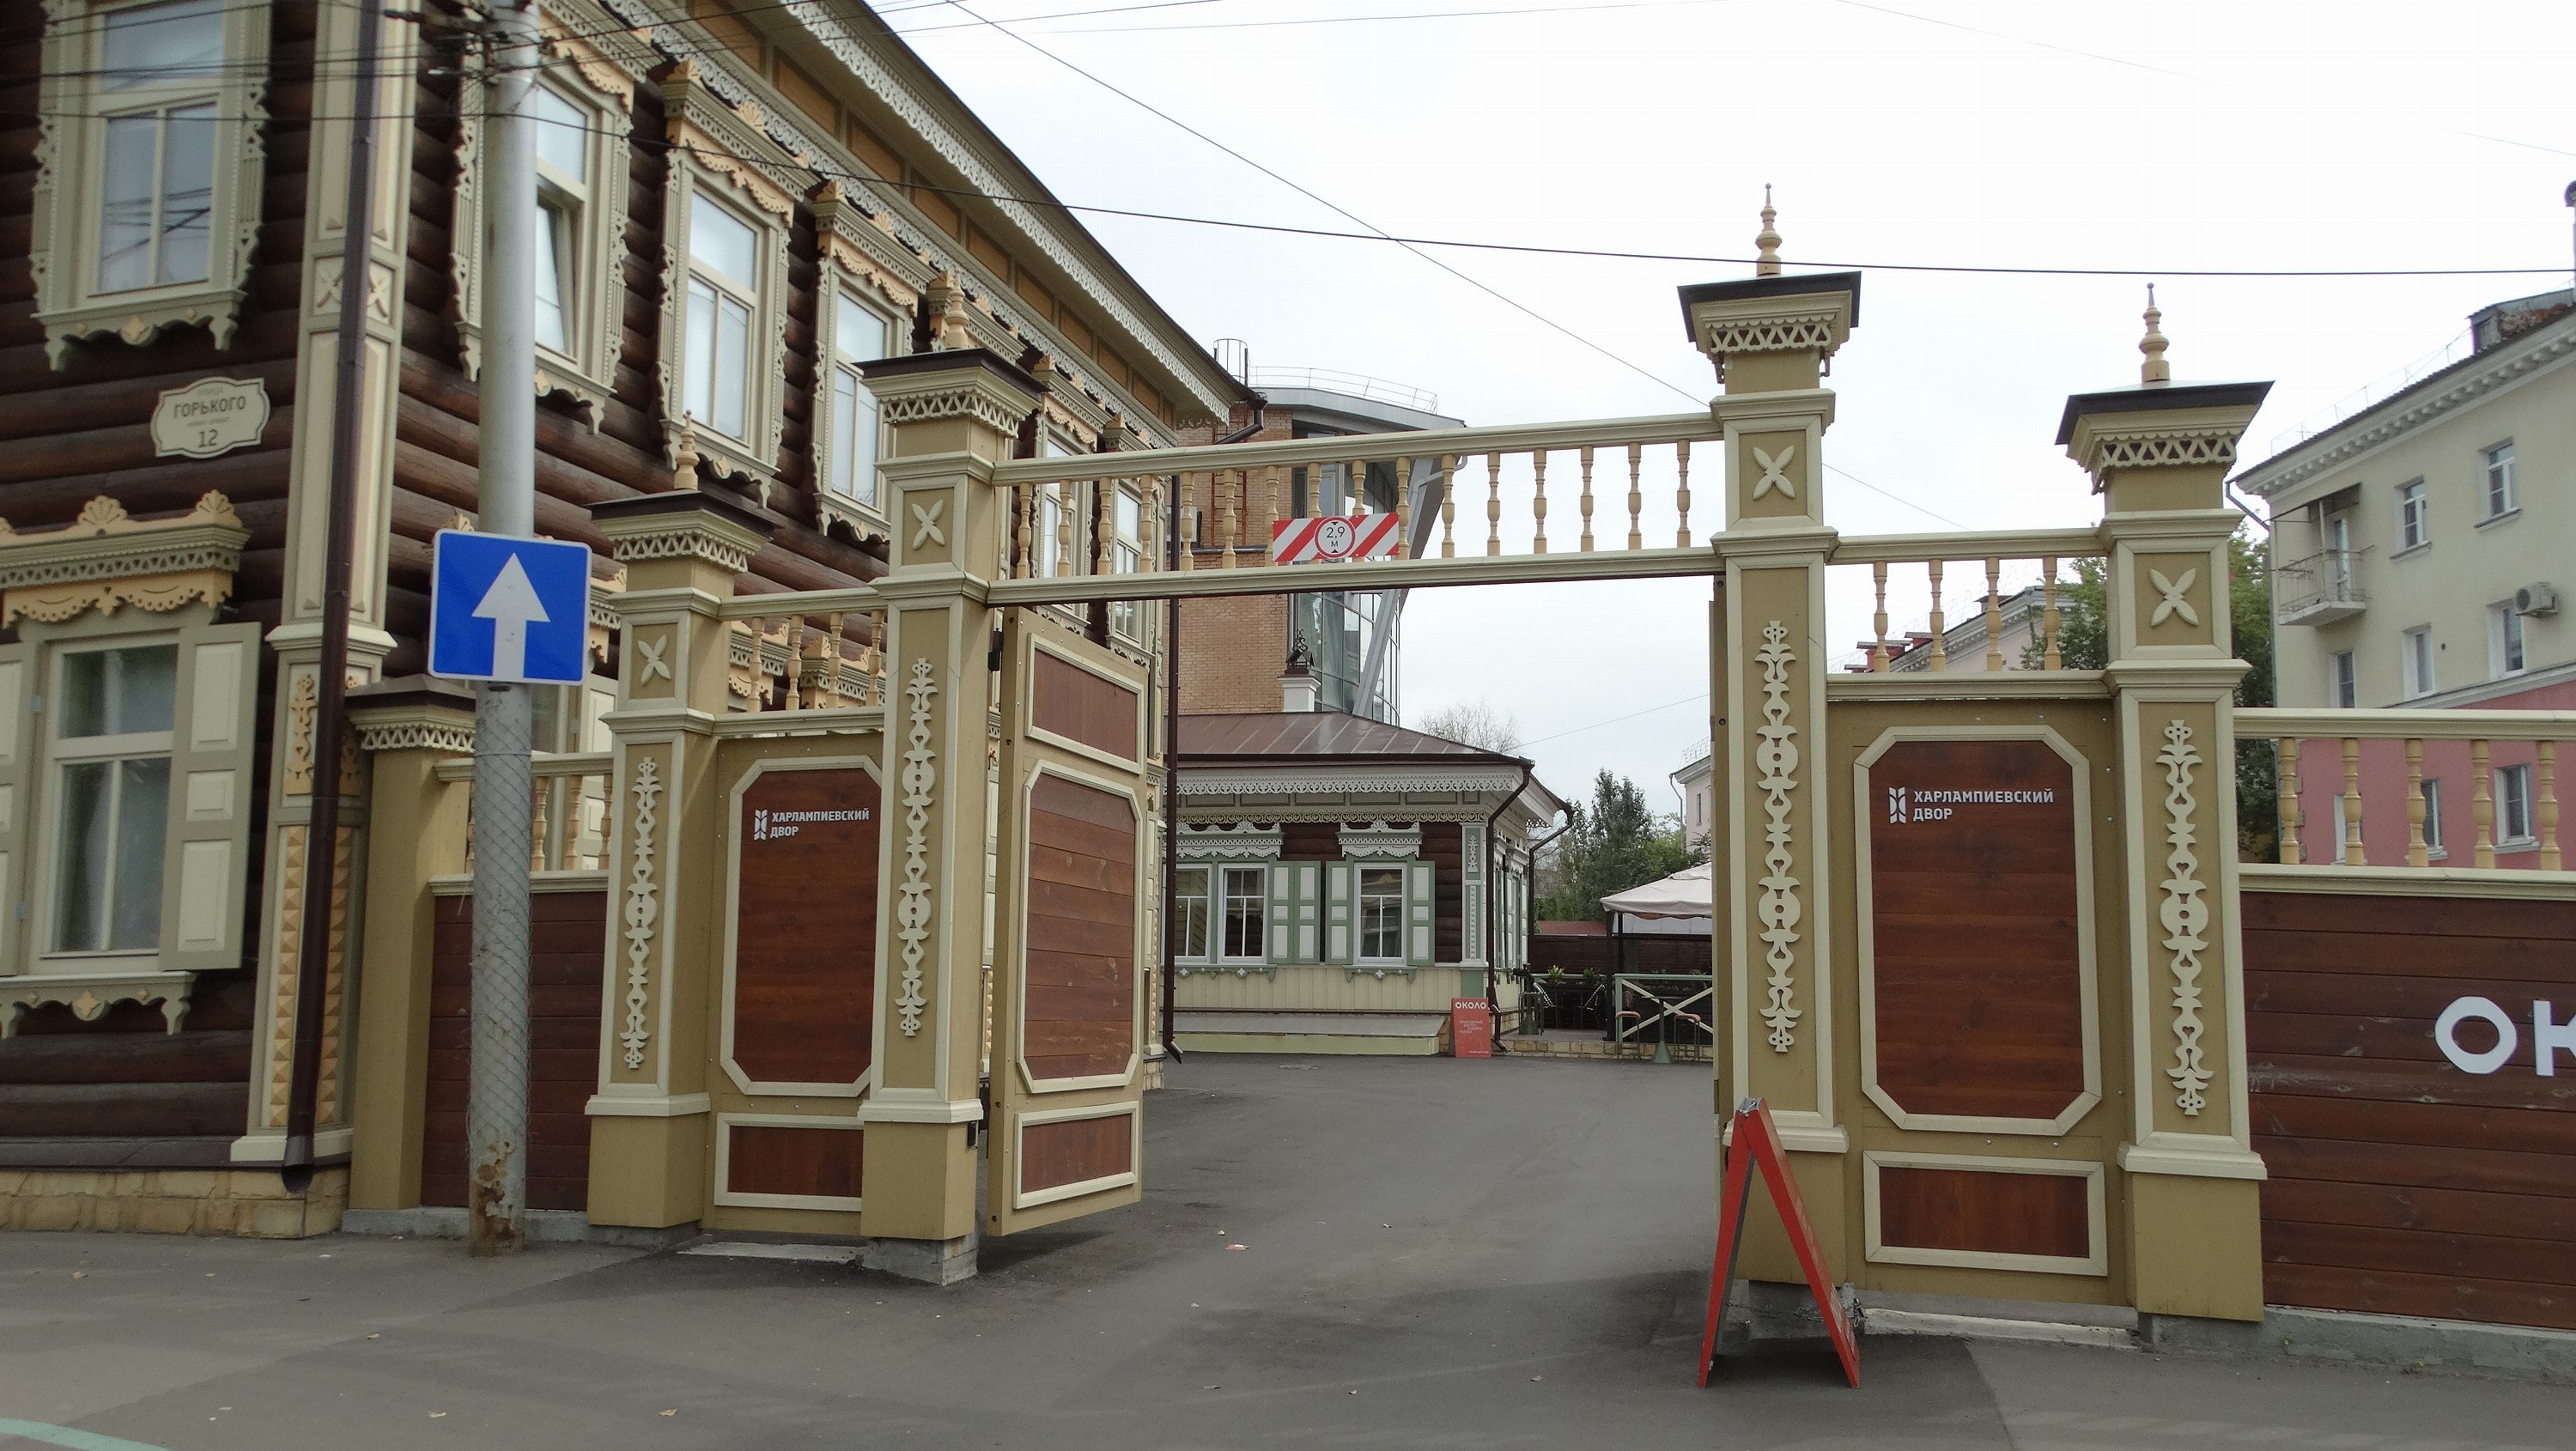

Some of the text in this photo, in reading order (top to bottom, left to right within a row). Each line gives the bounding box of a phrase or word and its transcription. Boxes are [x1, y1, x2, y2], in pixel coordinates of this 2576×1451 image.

[173, 395, 247, 418] ГОРЬКОГО
[198, 429, 219, 447] 12
[1326, 526, 1346, 539] 2,9
[1914, 788, 2054, 804] ХАРЛАМПИЕВСКИЙ
[772, 808, 870, 823] ХАРЛАМПИЕВСКИЙ
[1913, 808, 1953, 823] ДВОР
[770, 826, 799, 839] ДВОР
[1455, 1001, 1487, 1010] ОКОЛО
